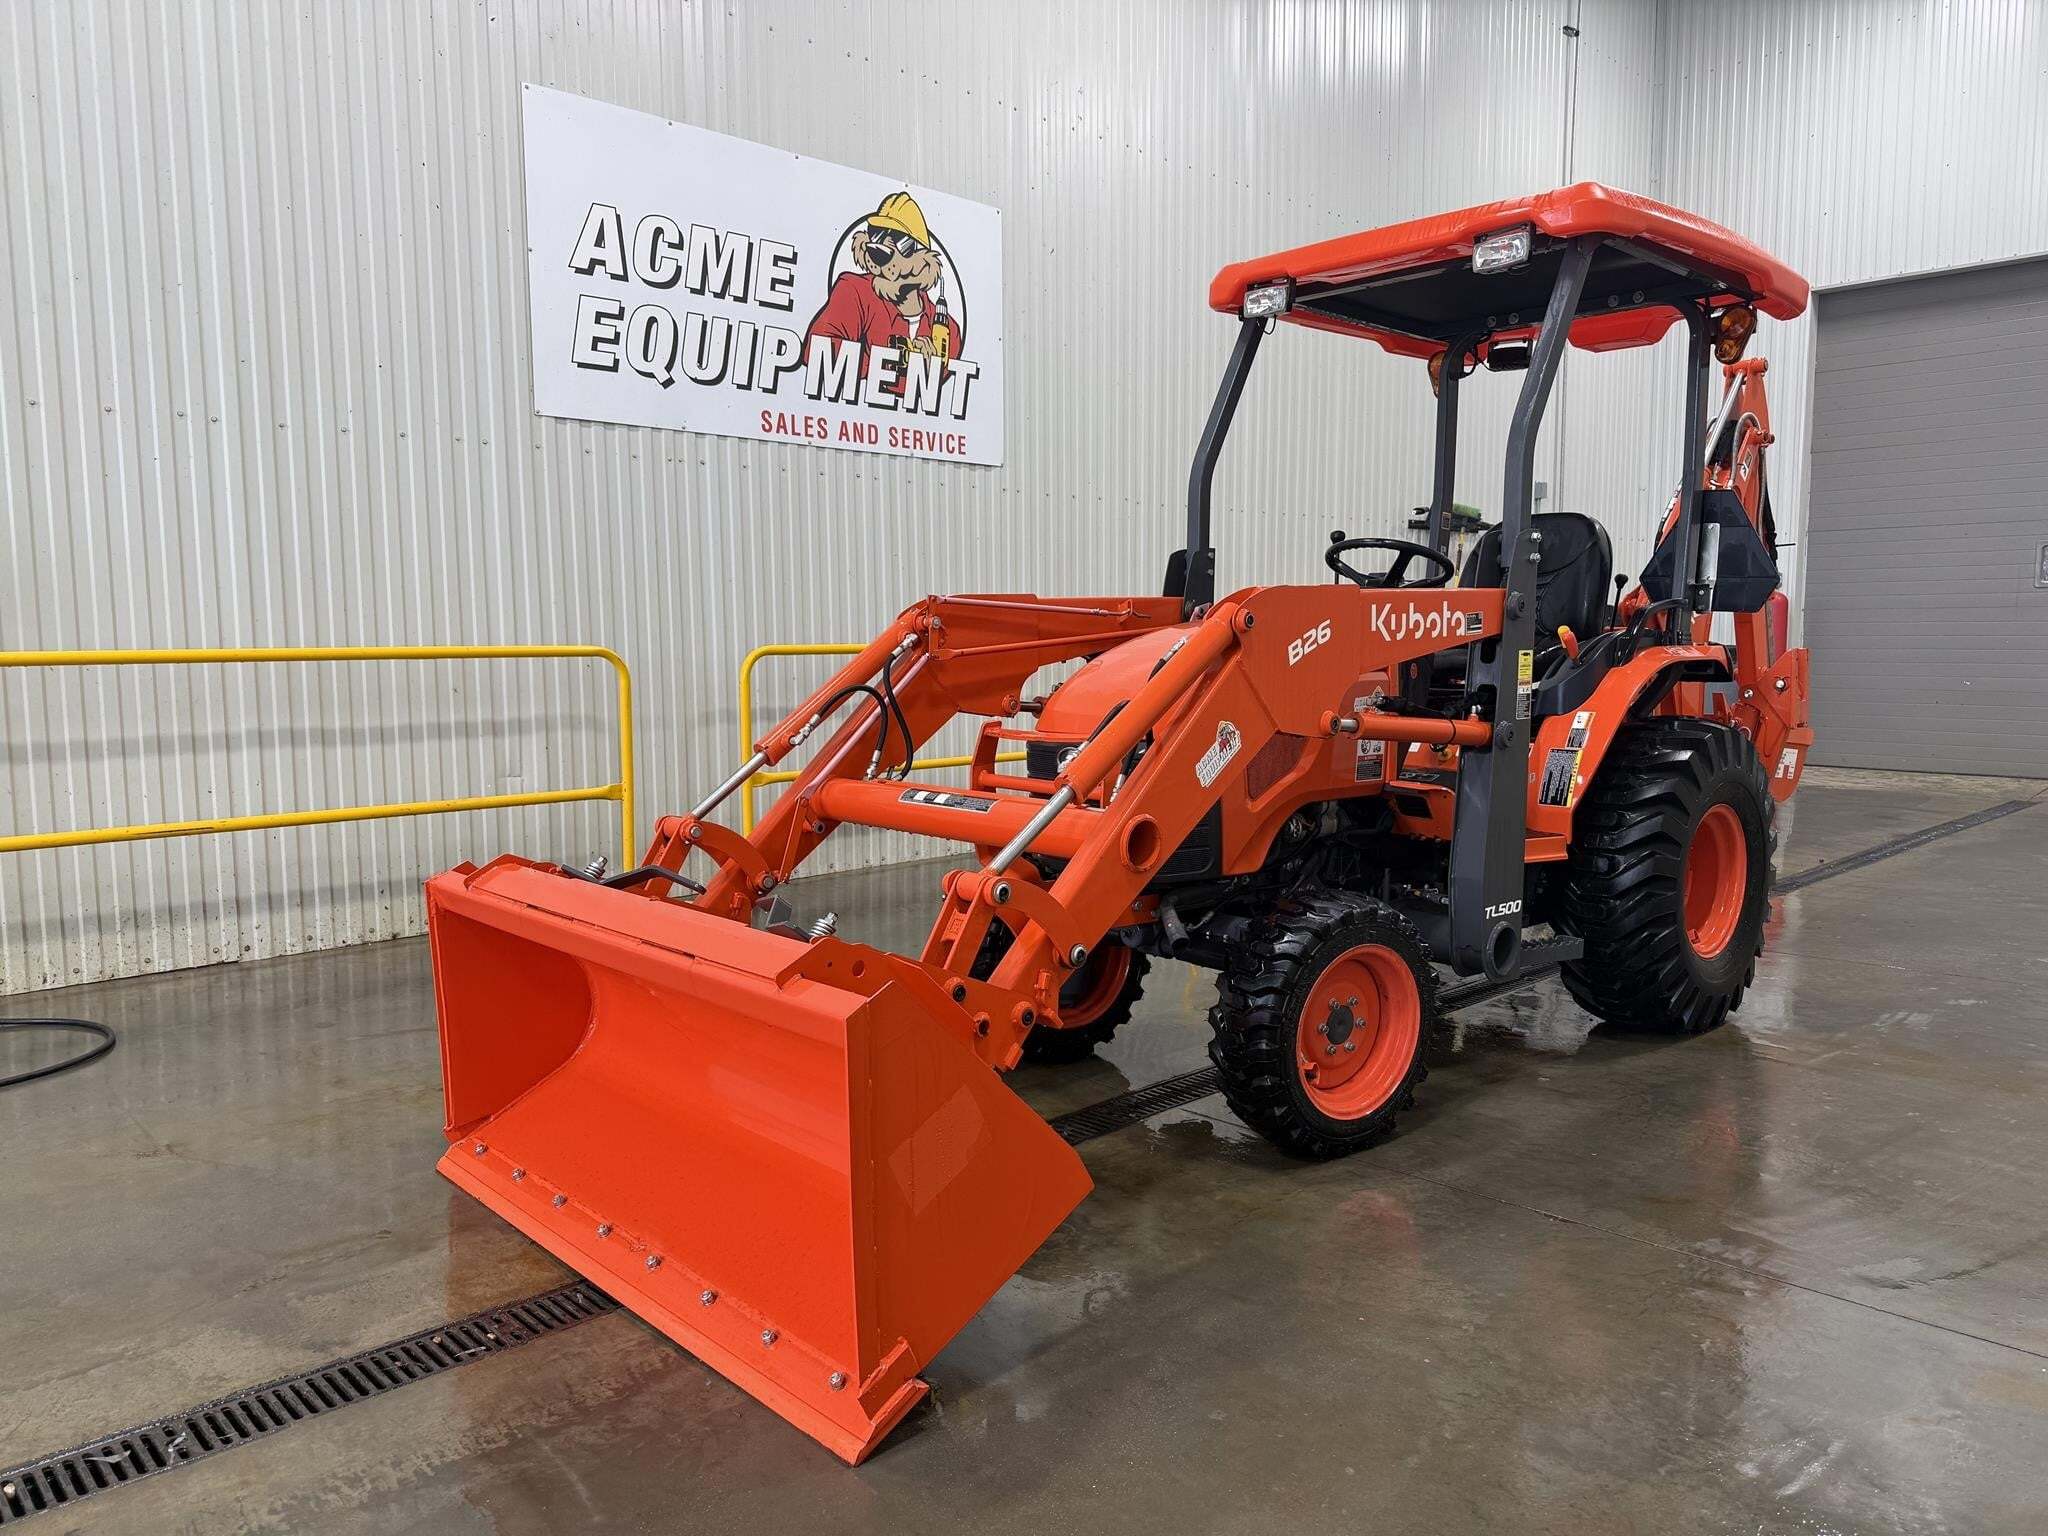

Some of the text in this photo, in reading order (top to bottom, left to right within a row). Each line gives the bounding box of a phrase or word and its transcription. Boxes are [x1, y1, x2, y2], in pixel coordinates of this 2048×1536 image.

[568, 202, 798, 312] ACME
[571, 294, 980, 420] EQUIPMENT
[761, 410, 967, 455] SALES AND SERVICE
[1287, 618, 1332, 667] B26
[1371, 601, 1465, 642] Kubota
[1484, 899, 1522, 920] TL500
